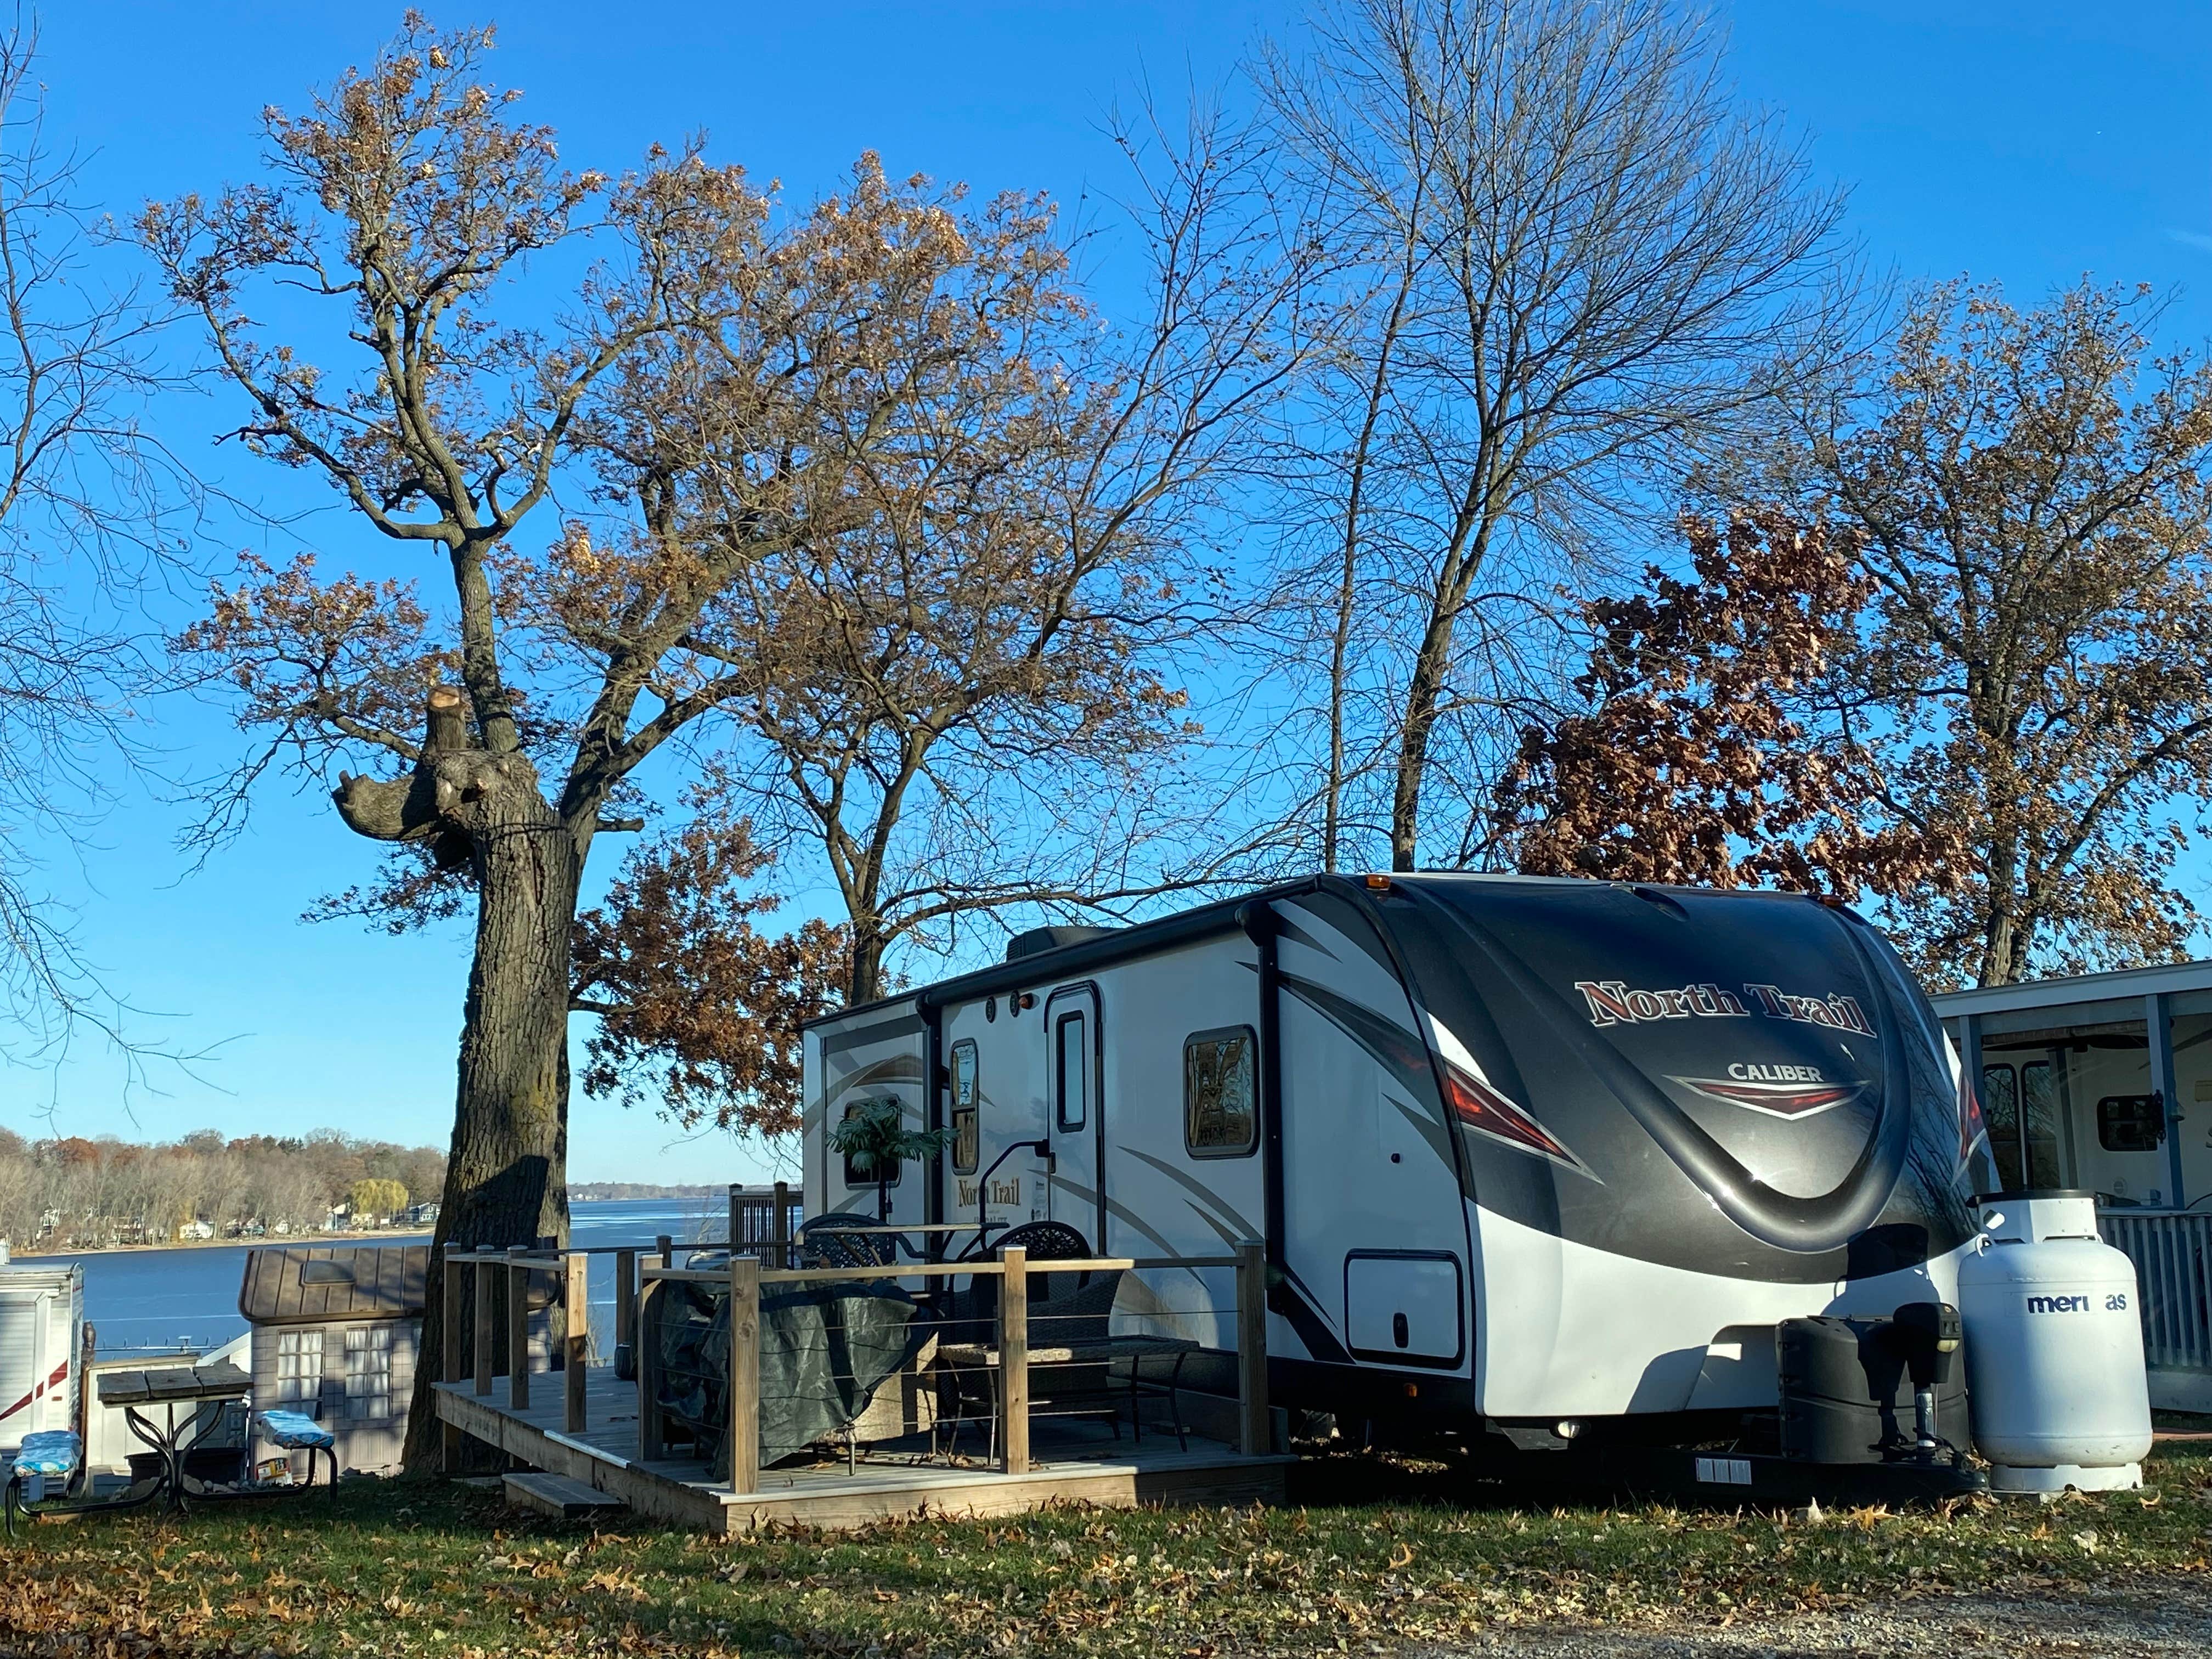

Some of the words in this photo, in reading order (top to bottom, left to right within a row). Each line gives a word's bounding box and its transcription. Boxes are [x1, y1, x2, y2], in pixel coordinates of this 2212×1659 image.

[1575, 981, 1751, 1027] North
[1743, 983, 1877, 1039] Trail
[1728, 1063, 1825, 1082] CALIBER
[991, 1177, 1022, 1206] Trail
